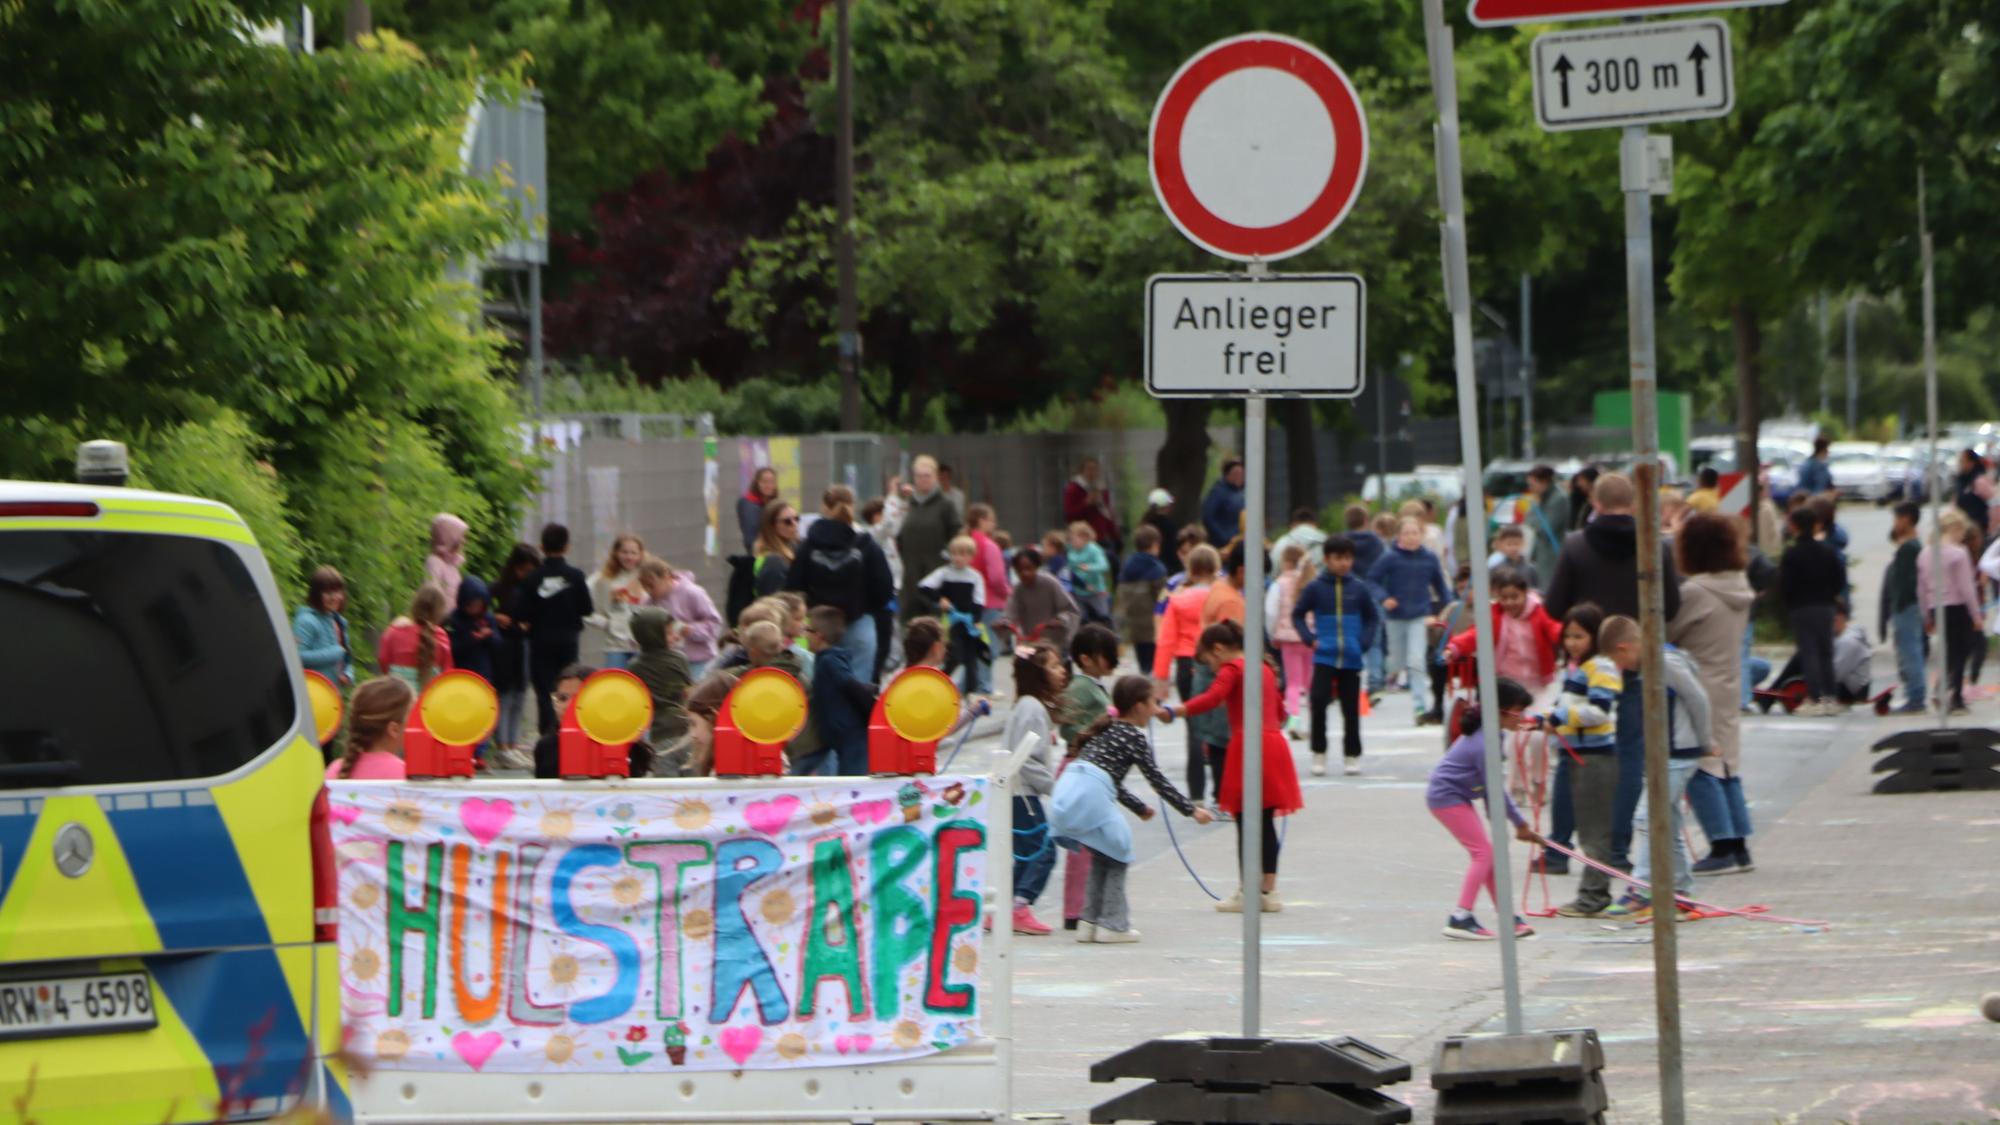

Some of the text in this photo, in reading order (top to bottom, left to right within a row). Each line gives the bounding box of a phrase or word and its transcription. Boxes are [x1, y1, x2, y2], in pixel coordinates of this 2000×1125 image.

[1586, 57, 1679, 95] 300 m
[1173, 297, 1337, 338] Anlieger
[1223, 342, 1287, 375] frei
[0, 978, 150, 1026] RW 4-6598
